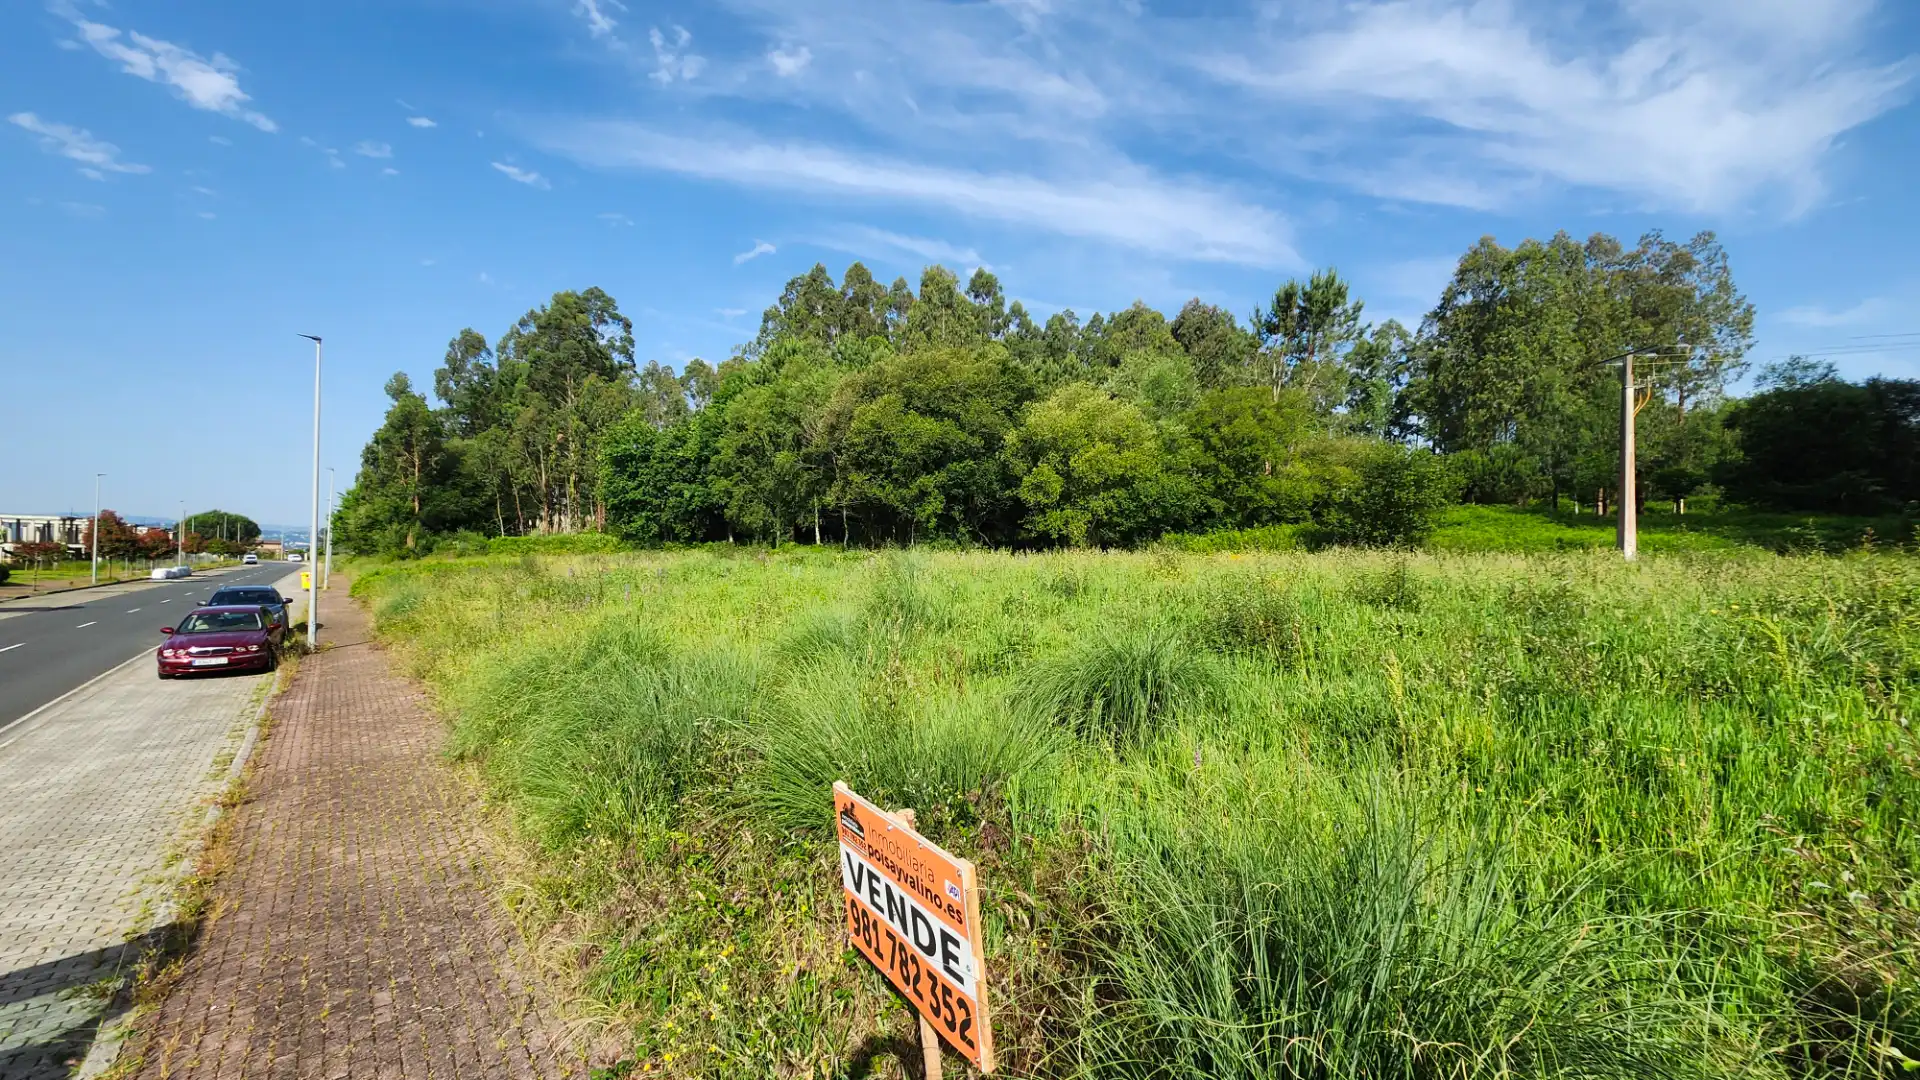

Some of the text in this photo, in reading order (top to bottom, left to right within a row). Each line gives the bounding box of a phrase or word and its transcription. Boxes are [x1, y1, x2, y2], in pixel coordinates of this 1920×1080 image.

[845, 851, 965, 986] VENDE
[867, 844, 964, 925] poisayvalino.es
[850, 898, 975, 1050] 981 782 352
